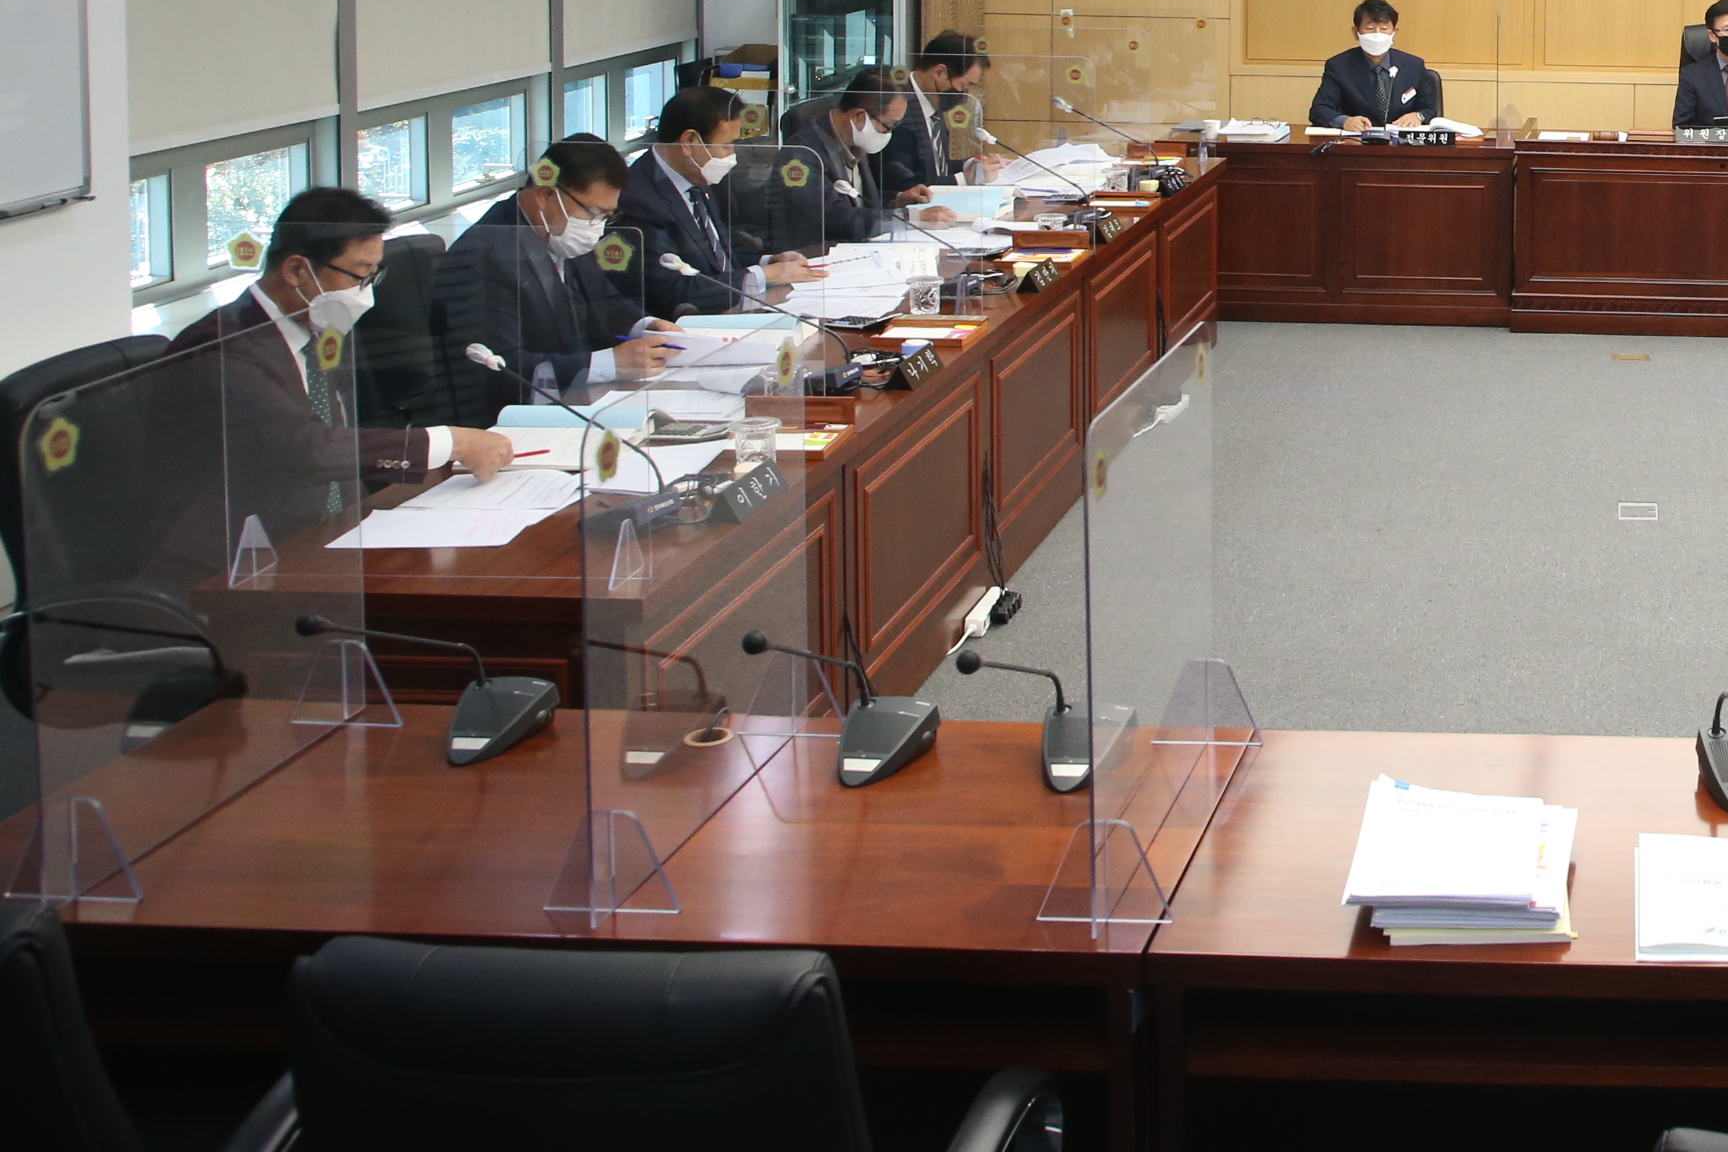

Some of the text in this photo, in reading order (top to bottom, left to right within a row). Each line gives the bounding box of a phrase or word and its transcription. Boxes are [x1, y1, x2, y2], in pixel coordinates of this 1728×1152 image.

[1405, 132, 1449, 145] 전문위원
[1682, 128, 1728, 141] 위원장
[907, 349, 939, 381] 나기학
[737, 466, 781, 508] 이한기
